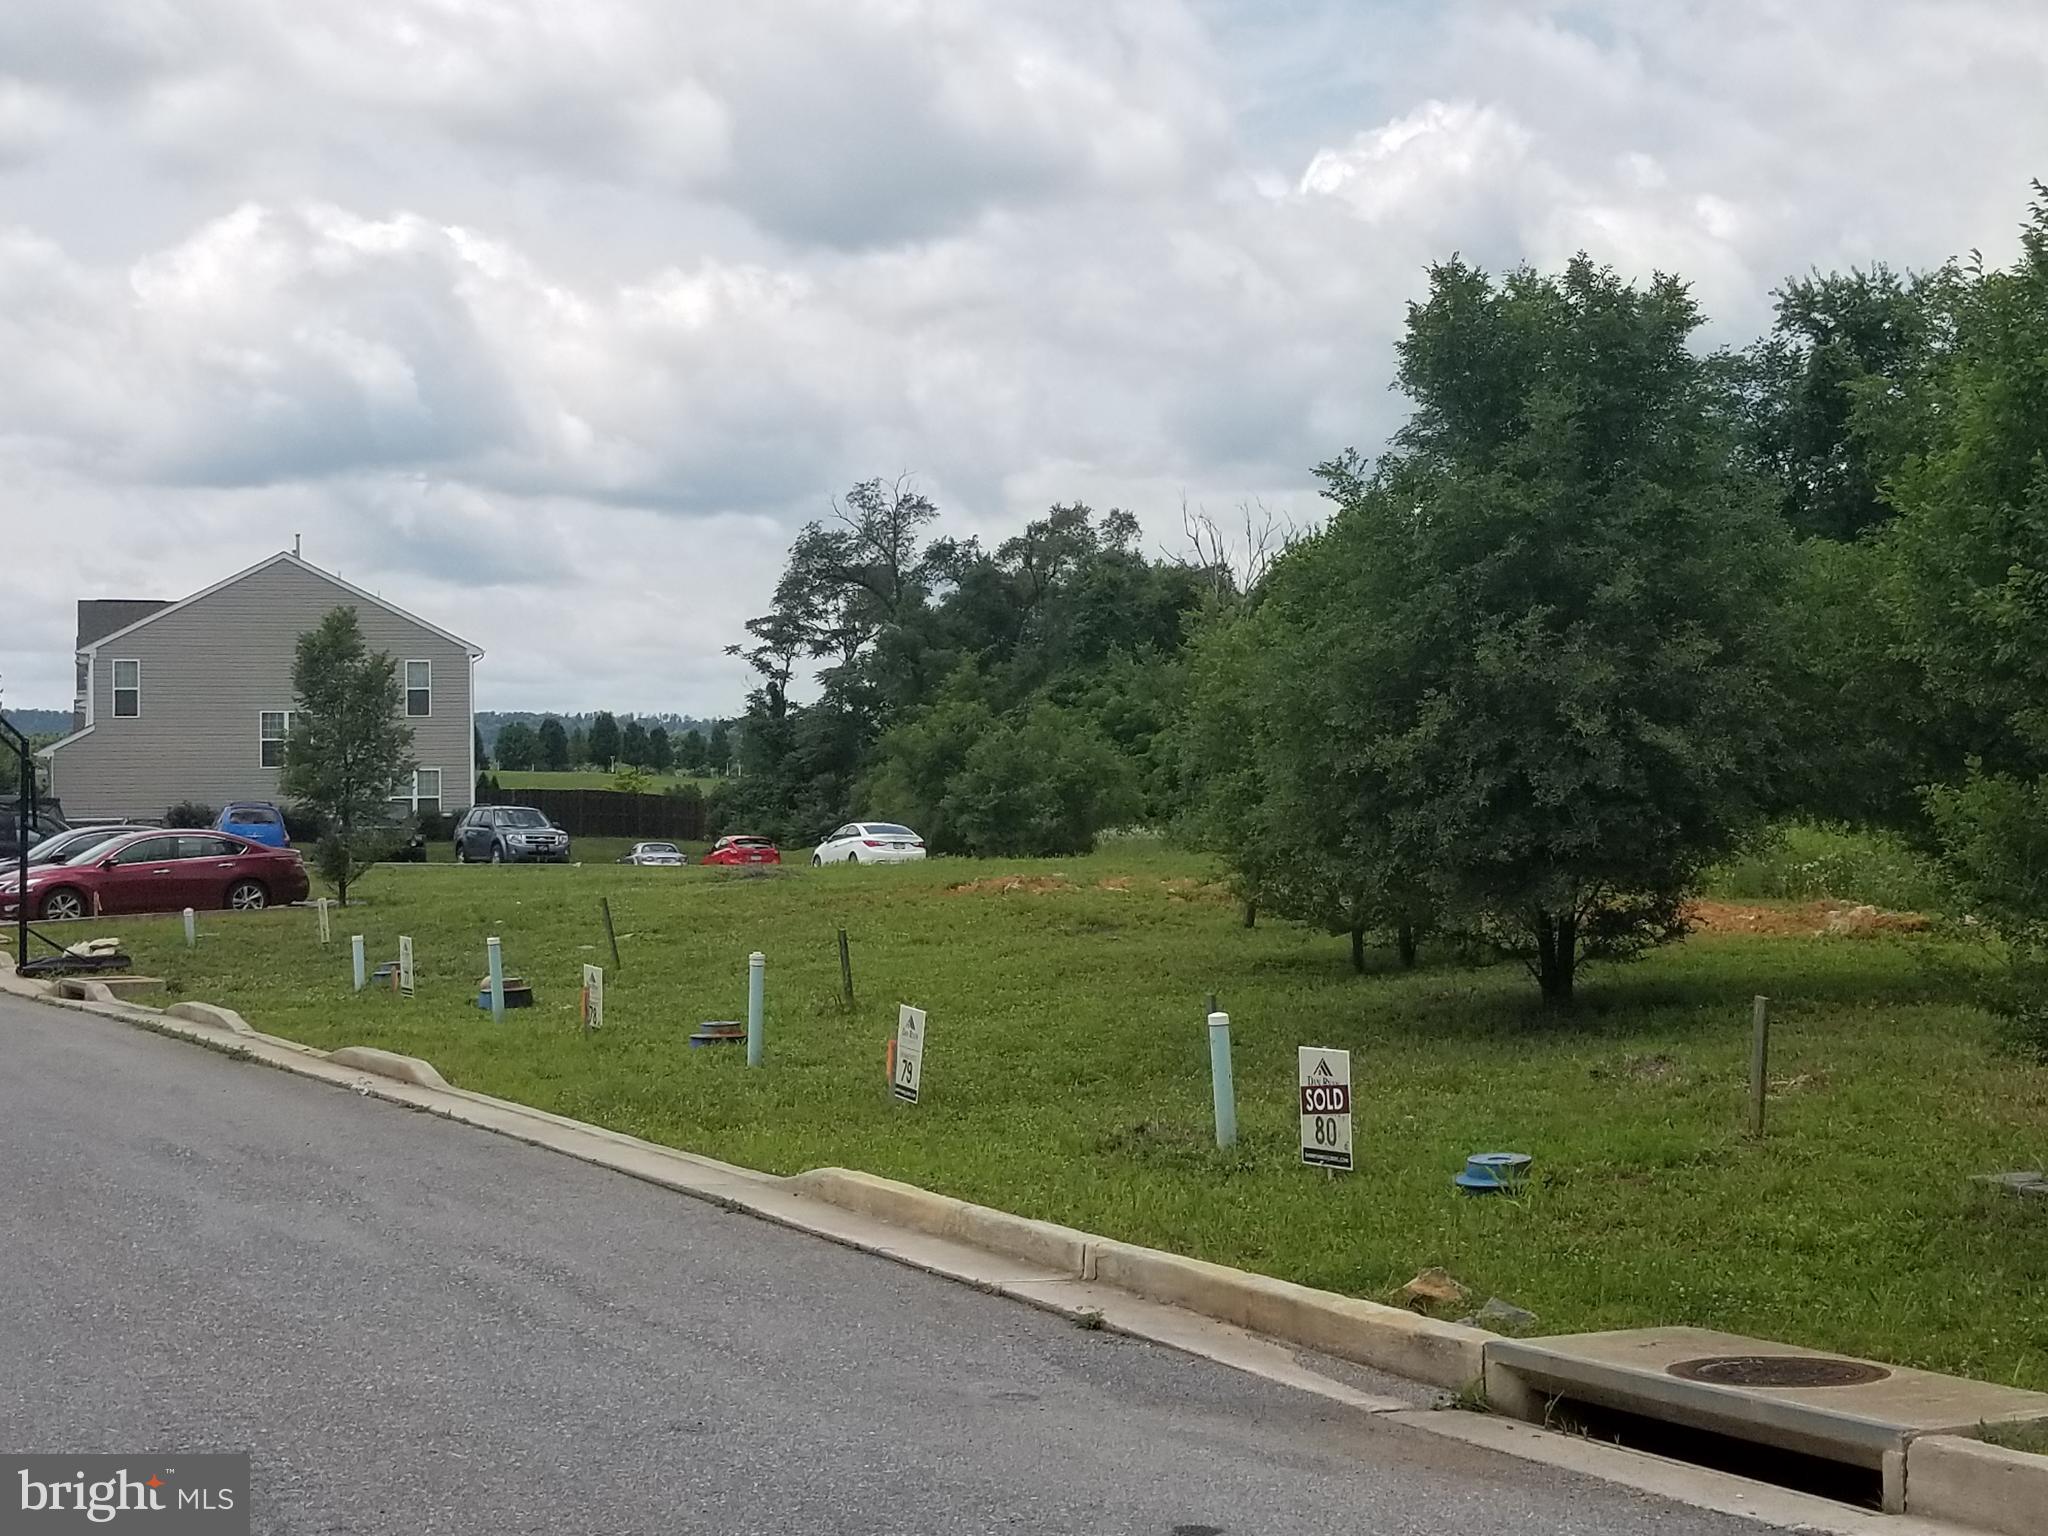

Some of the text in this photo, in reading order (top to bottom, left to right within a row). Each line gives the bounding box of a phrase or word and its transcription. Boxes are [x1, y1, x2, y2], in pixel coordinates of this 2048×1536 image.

[901, 1059, 913, 1083] 79
[1305, 1088, 1344, 1112] SOLD
[1315, 1116, 1337, 1147] 80
